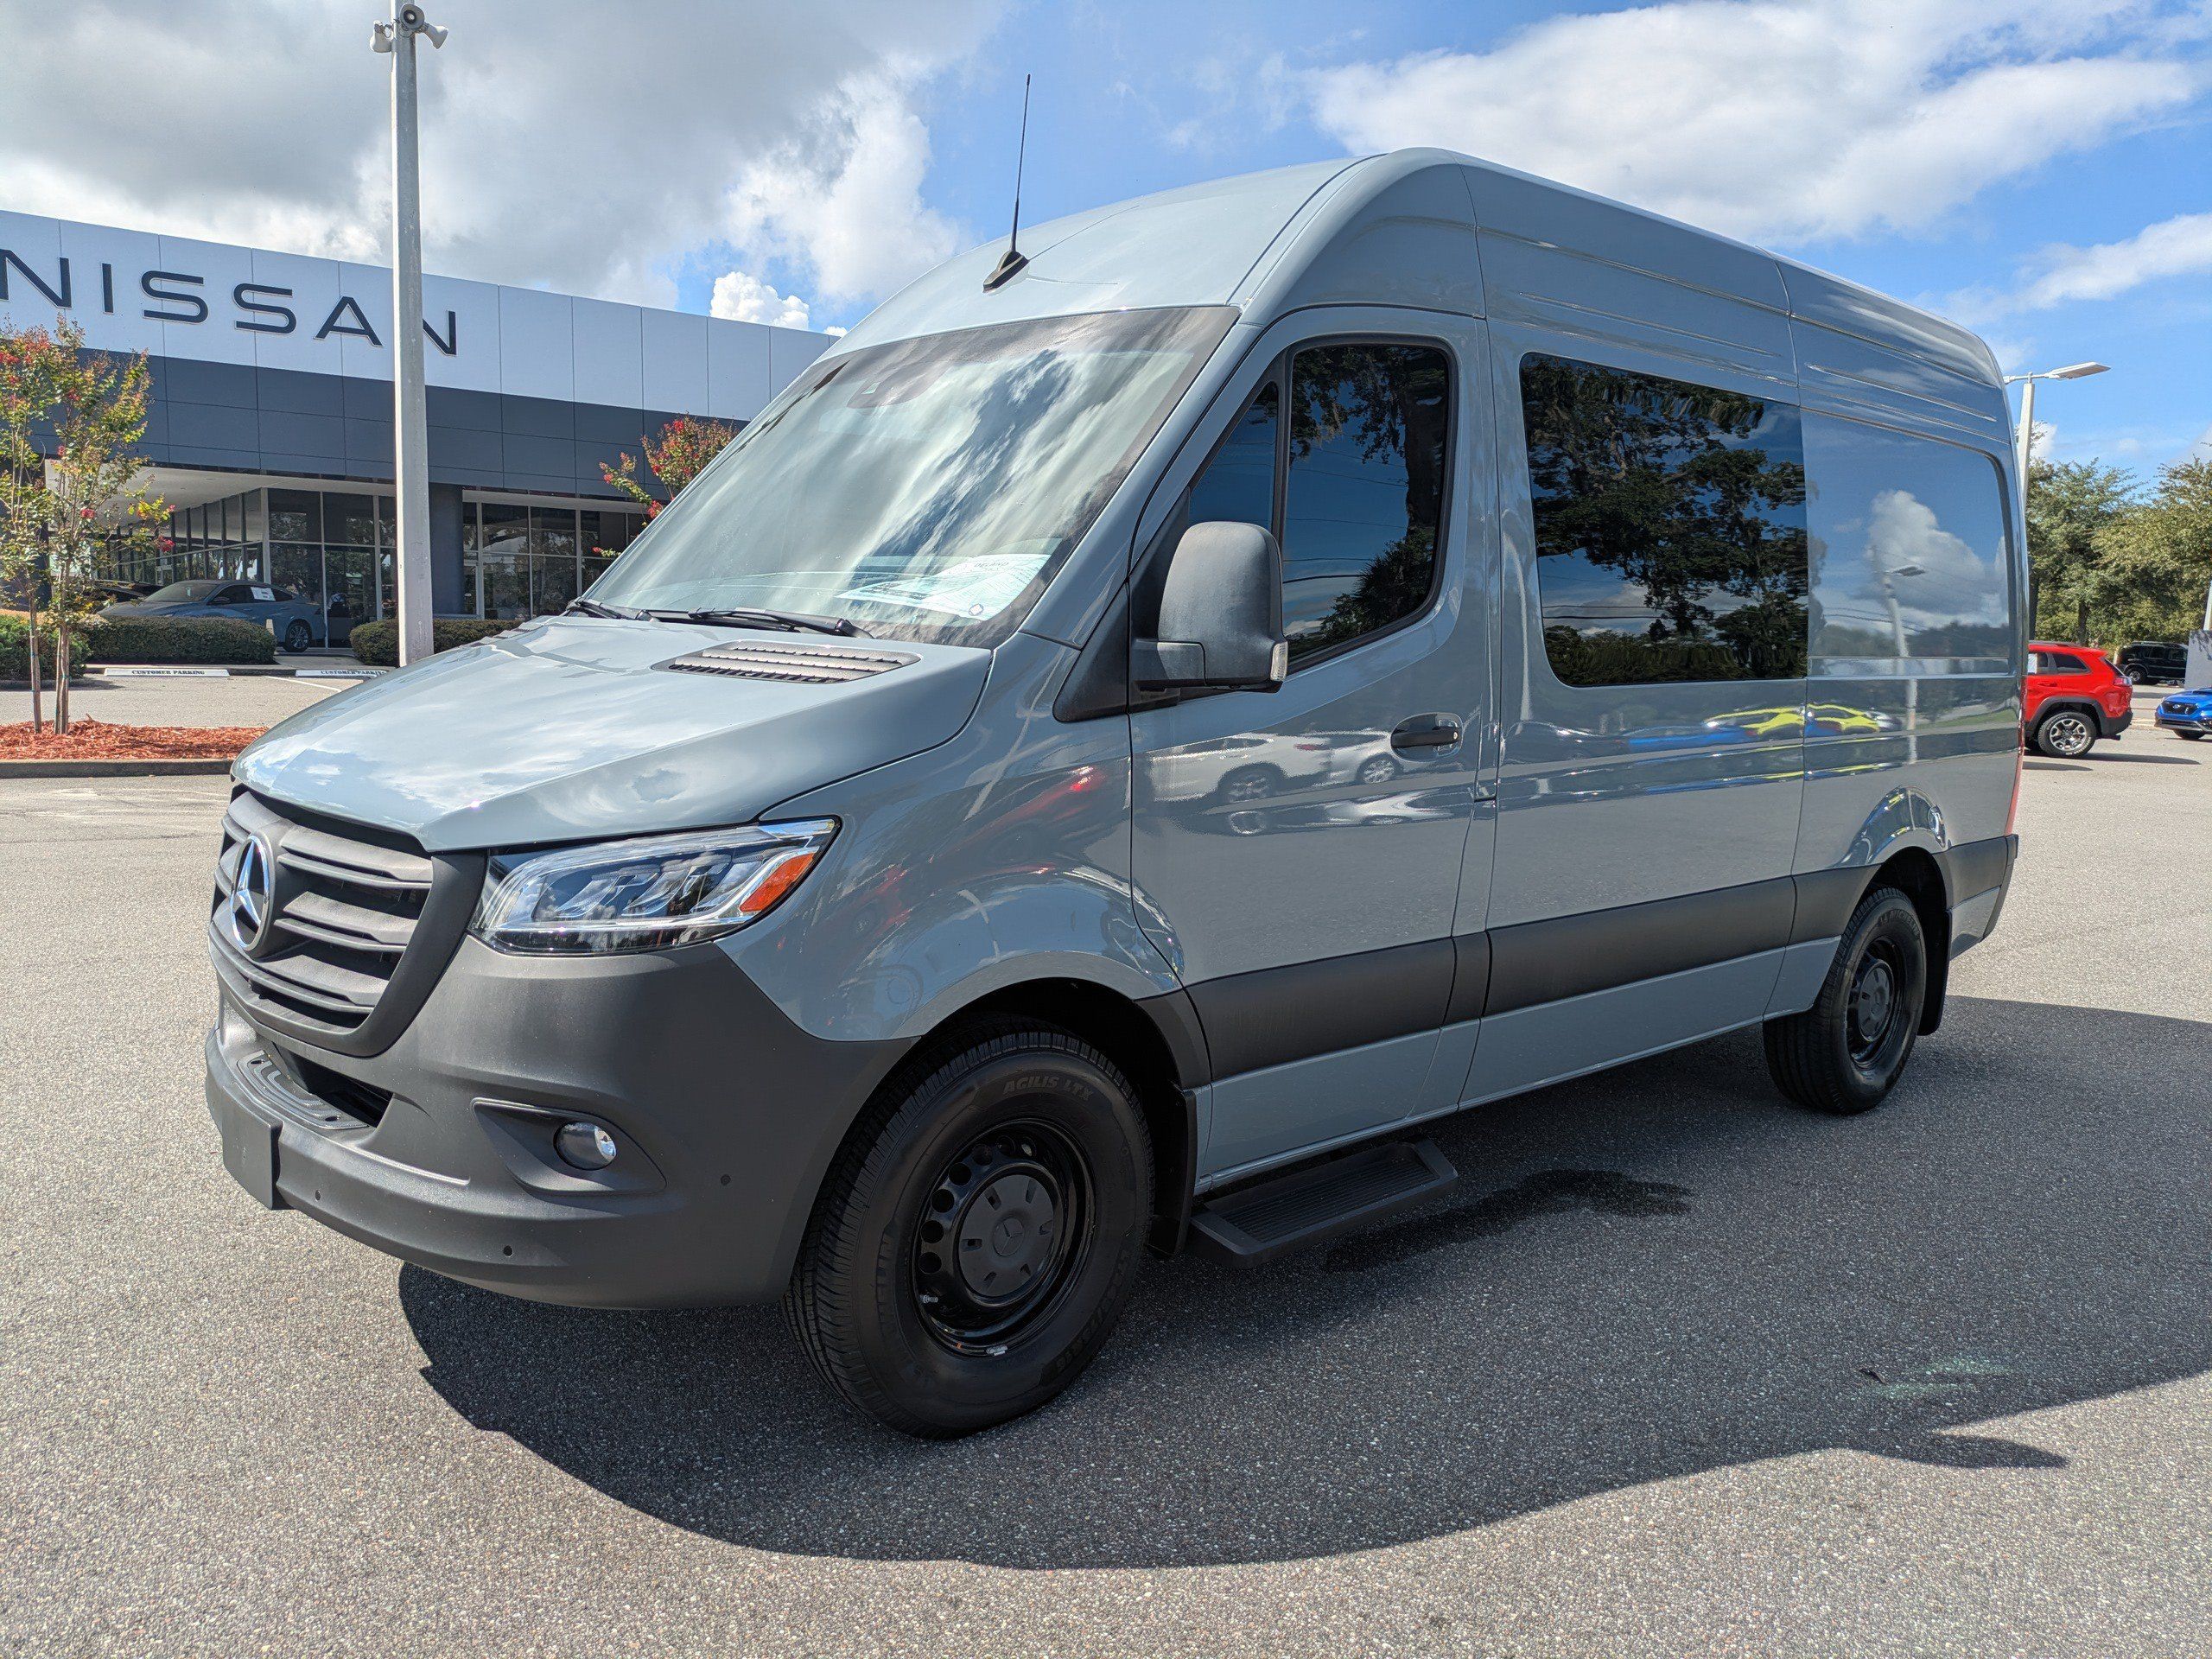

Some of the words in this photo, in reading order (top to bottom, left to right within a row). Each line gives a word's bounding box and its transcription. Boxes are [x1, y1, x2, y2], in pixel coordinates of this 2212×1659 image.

[0, 248, 457, 357] NISSAN
[1002, 1076, 1060, 1096] AGILIS
[1064, 1079, 1094, 1101] LTX
